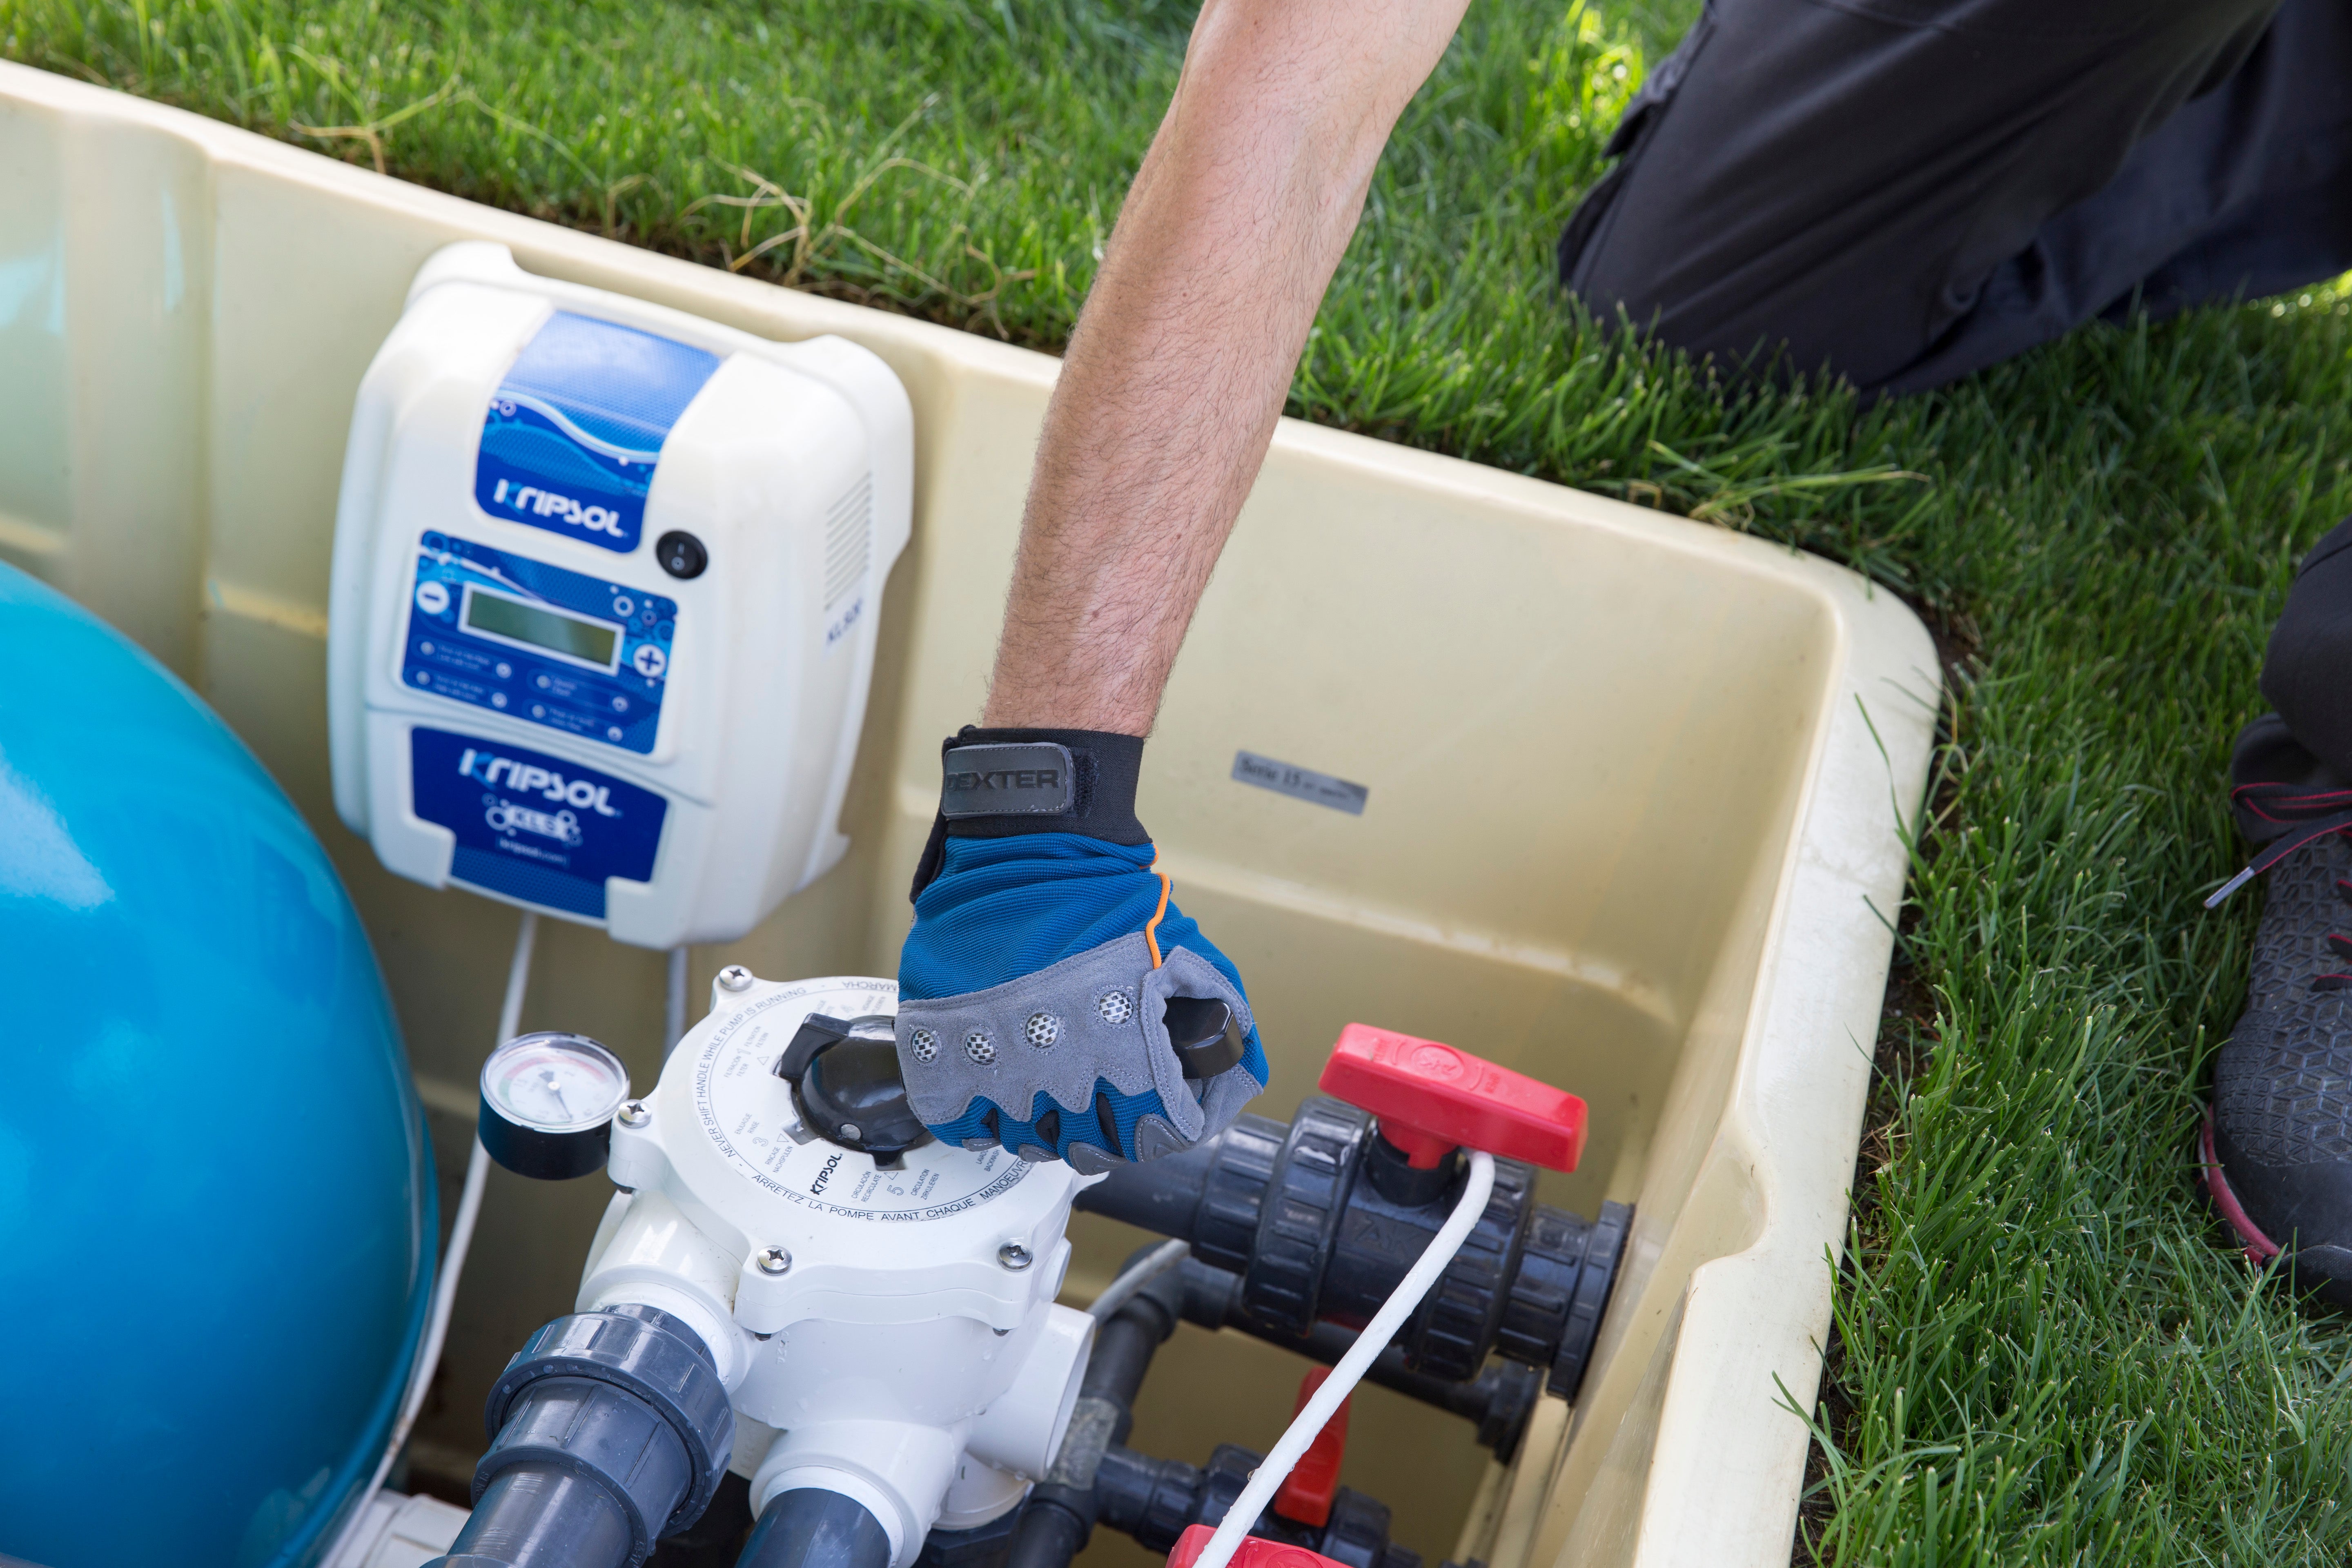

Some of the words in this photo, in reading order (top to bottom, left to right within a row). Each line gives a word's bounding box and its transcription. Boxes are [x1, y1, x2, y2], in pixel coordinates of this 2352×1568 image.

[945, 769, 1059, 791] DEXTER
[842, 981, 898, 991] MARCHA
[755, 987, 806, 1010] RUNNING
[744, 1007, 756, 1017] IS
[719, 1013, 743, 1036] PUMP
[702, 1034, 724, 1060] WHILE
[696, 1062, 710, 1097] HANDLE
[737, 1062, 749, 1078] FILTER
[697, 1101, 714, 1126] SHIFT
[747, 1121, 760, 1134] RINSE
[708, 1128, 736, 1157] NEVER
[753, 1137, 769, 1147] 3
[984, 1149, 1000, 1172] BACKWASH
[751, 1175, 804, 1204] ARRETEZ
[808, 1201, 823, 1212] LA
[829, 1207, 875, 1220] POMPE
[880, 1212, 920, 1221] AVANT
[926, 1198, 976, 1218] CHAQUE
[979, 1160, 1028, 1200] MANOEUVR
[861, 1173, 882, 1203] RECIRCULATE
[887, 1185, 904, 1196] 5
[910, 1168, 930, 1196] CIRCULATION
[920, 1172, 940, 1200] ZIRKULIEREN
